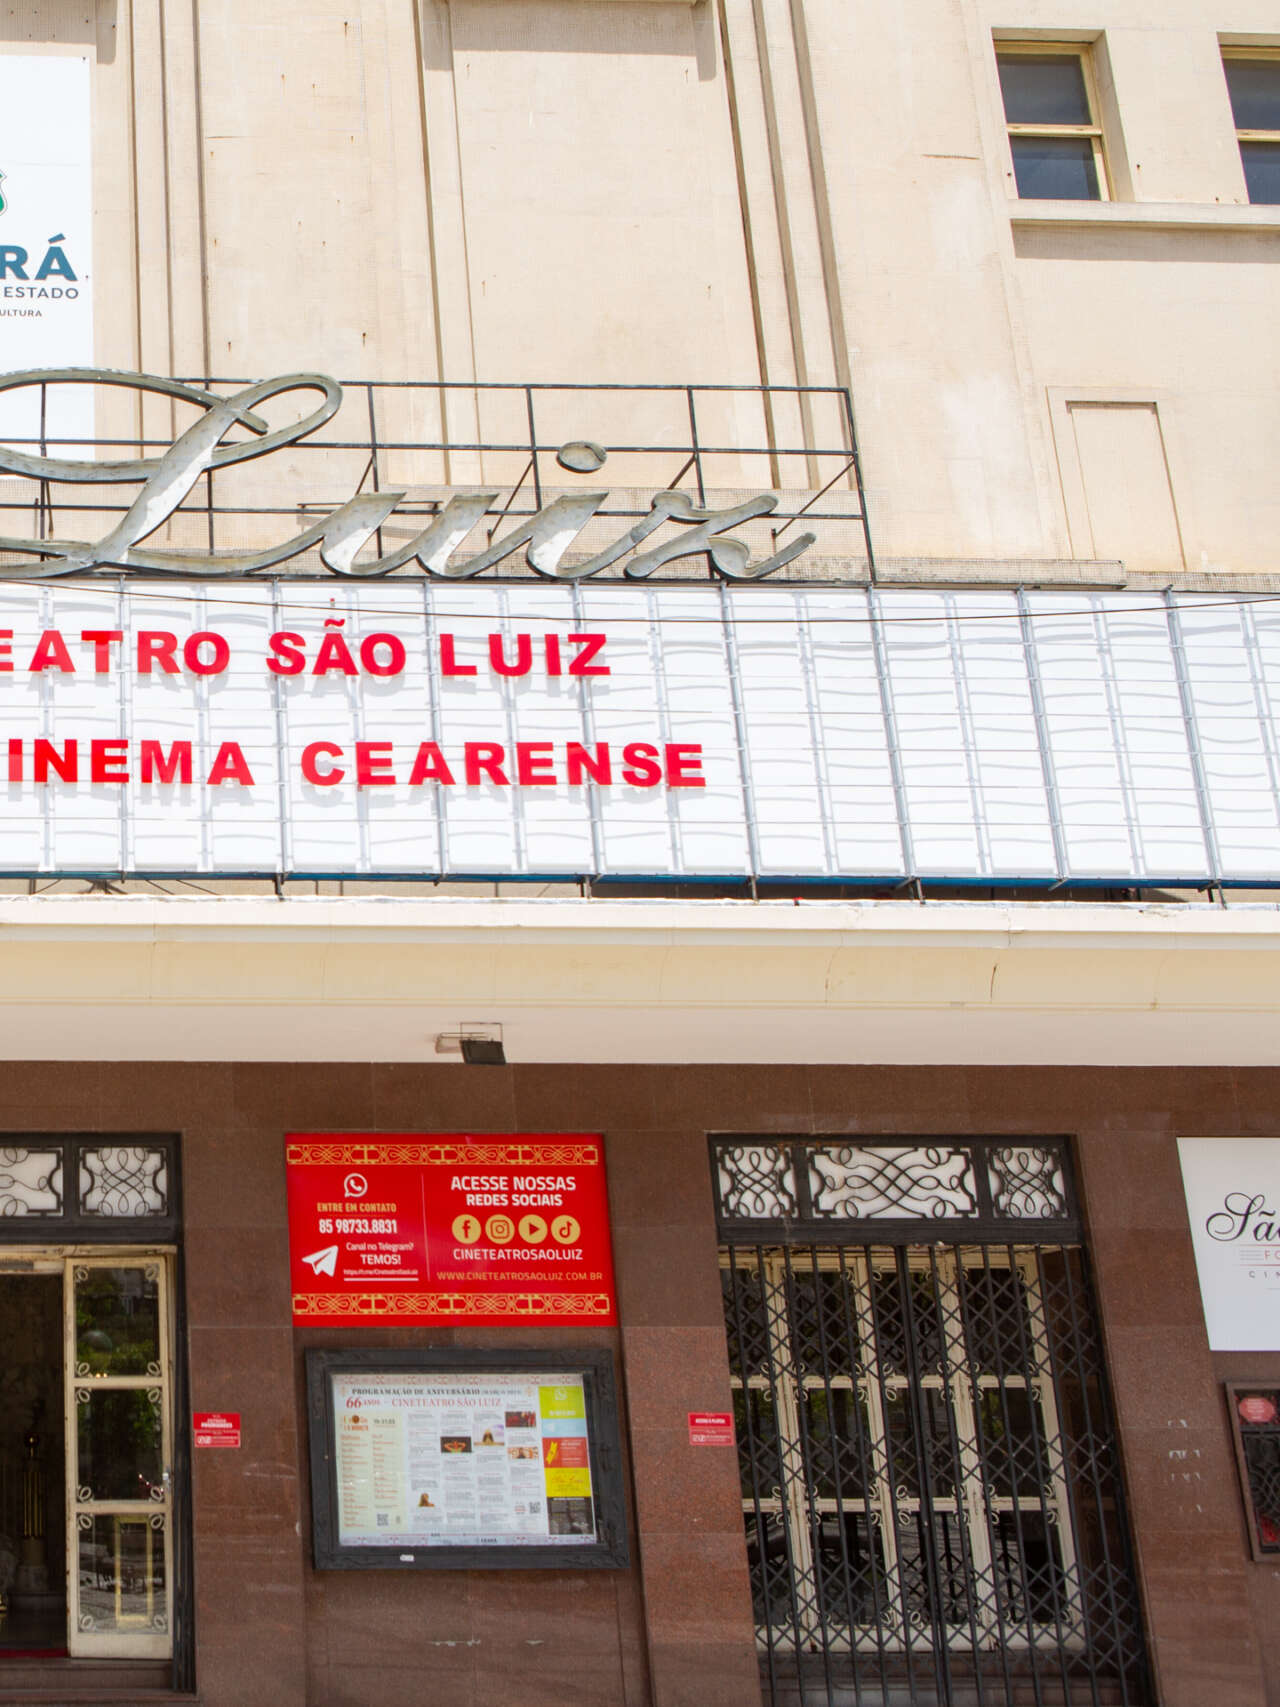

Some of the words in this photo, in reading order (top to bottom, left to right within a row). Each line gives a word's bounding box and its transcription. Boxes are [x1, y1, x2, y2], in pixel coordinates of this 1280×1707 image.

[4, 286, 79, 300] ESTADO
[266, 618, 407, 677] SÃO
[439, 632, 611, 677] LUIZ
[301, 741, 707, 788] CEARENSE
[451, 1176, 509, 1191] ACESSE
[513, 1176, 577, 1191] NOSSAS
[466, 1193, 509, 1207] REDES
[511, 1194, 563, 1207] SOCIAIS
[317, 1202, 343, 1213] ENTRE
[345, 1202, 358, 1213] EM
[360, 1202, 397, 1213] CONTATO
[1206, 1192, 1280, 1241] Sã
[319, 1218, 334, 1234] 85
[346, 1242, 367, 1251] Canal
[360, 1254, 401, 1265] TEMOS!
[453, 1248, 583, 1261] CINETEATROSAOLUIZ
[436, 1271, 603, 1281] WWW.CINETEATROSAOLUIZ.COM.BR
[345, 1398, 363, 1409] 66
[391, 1398, 456, 1408] CINETEATRO
